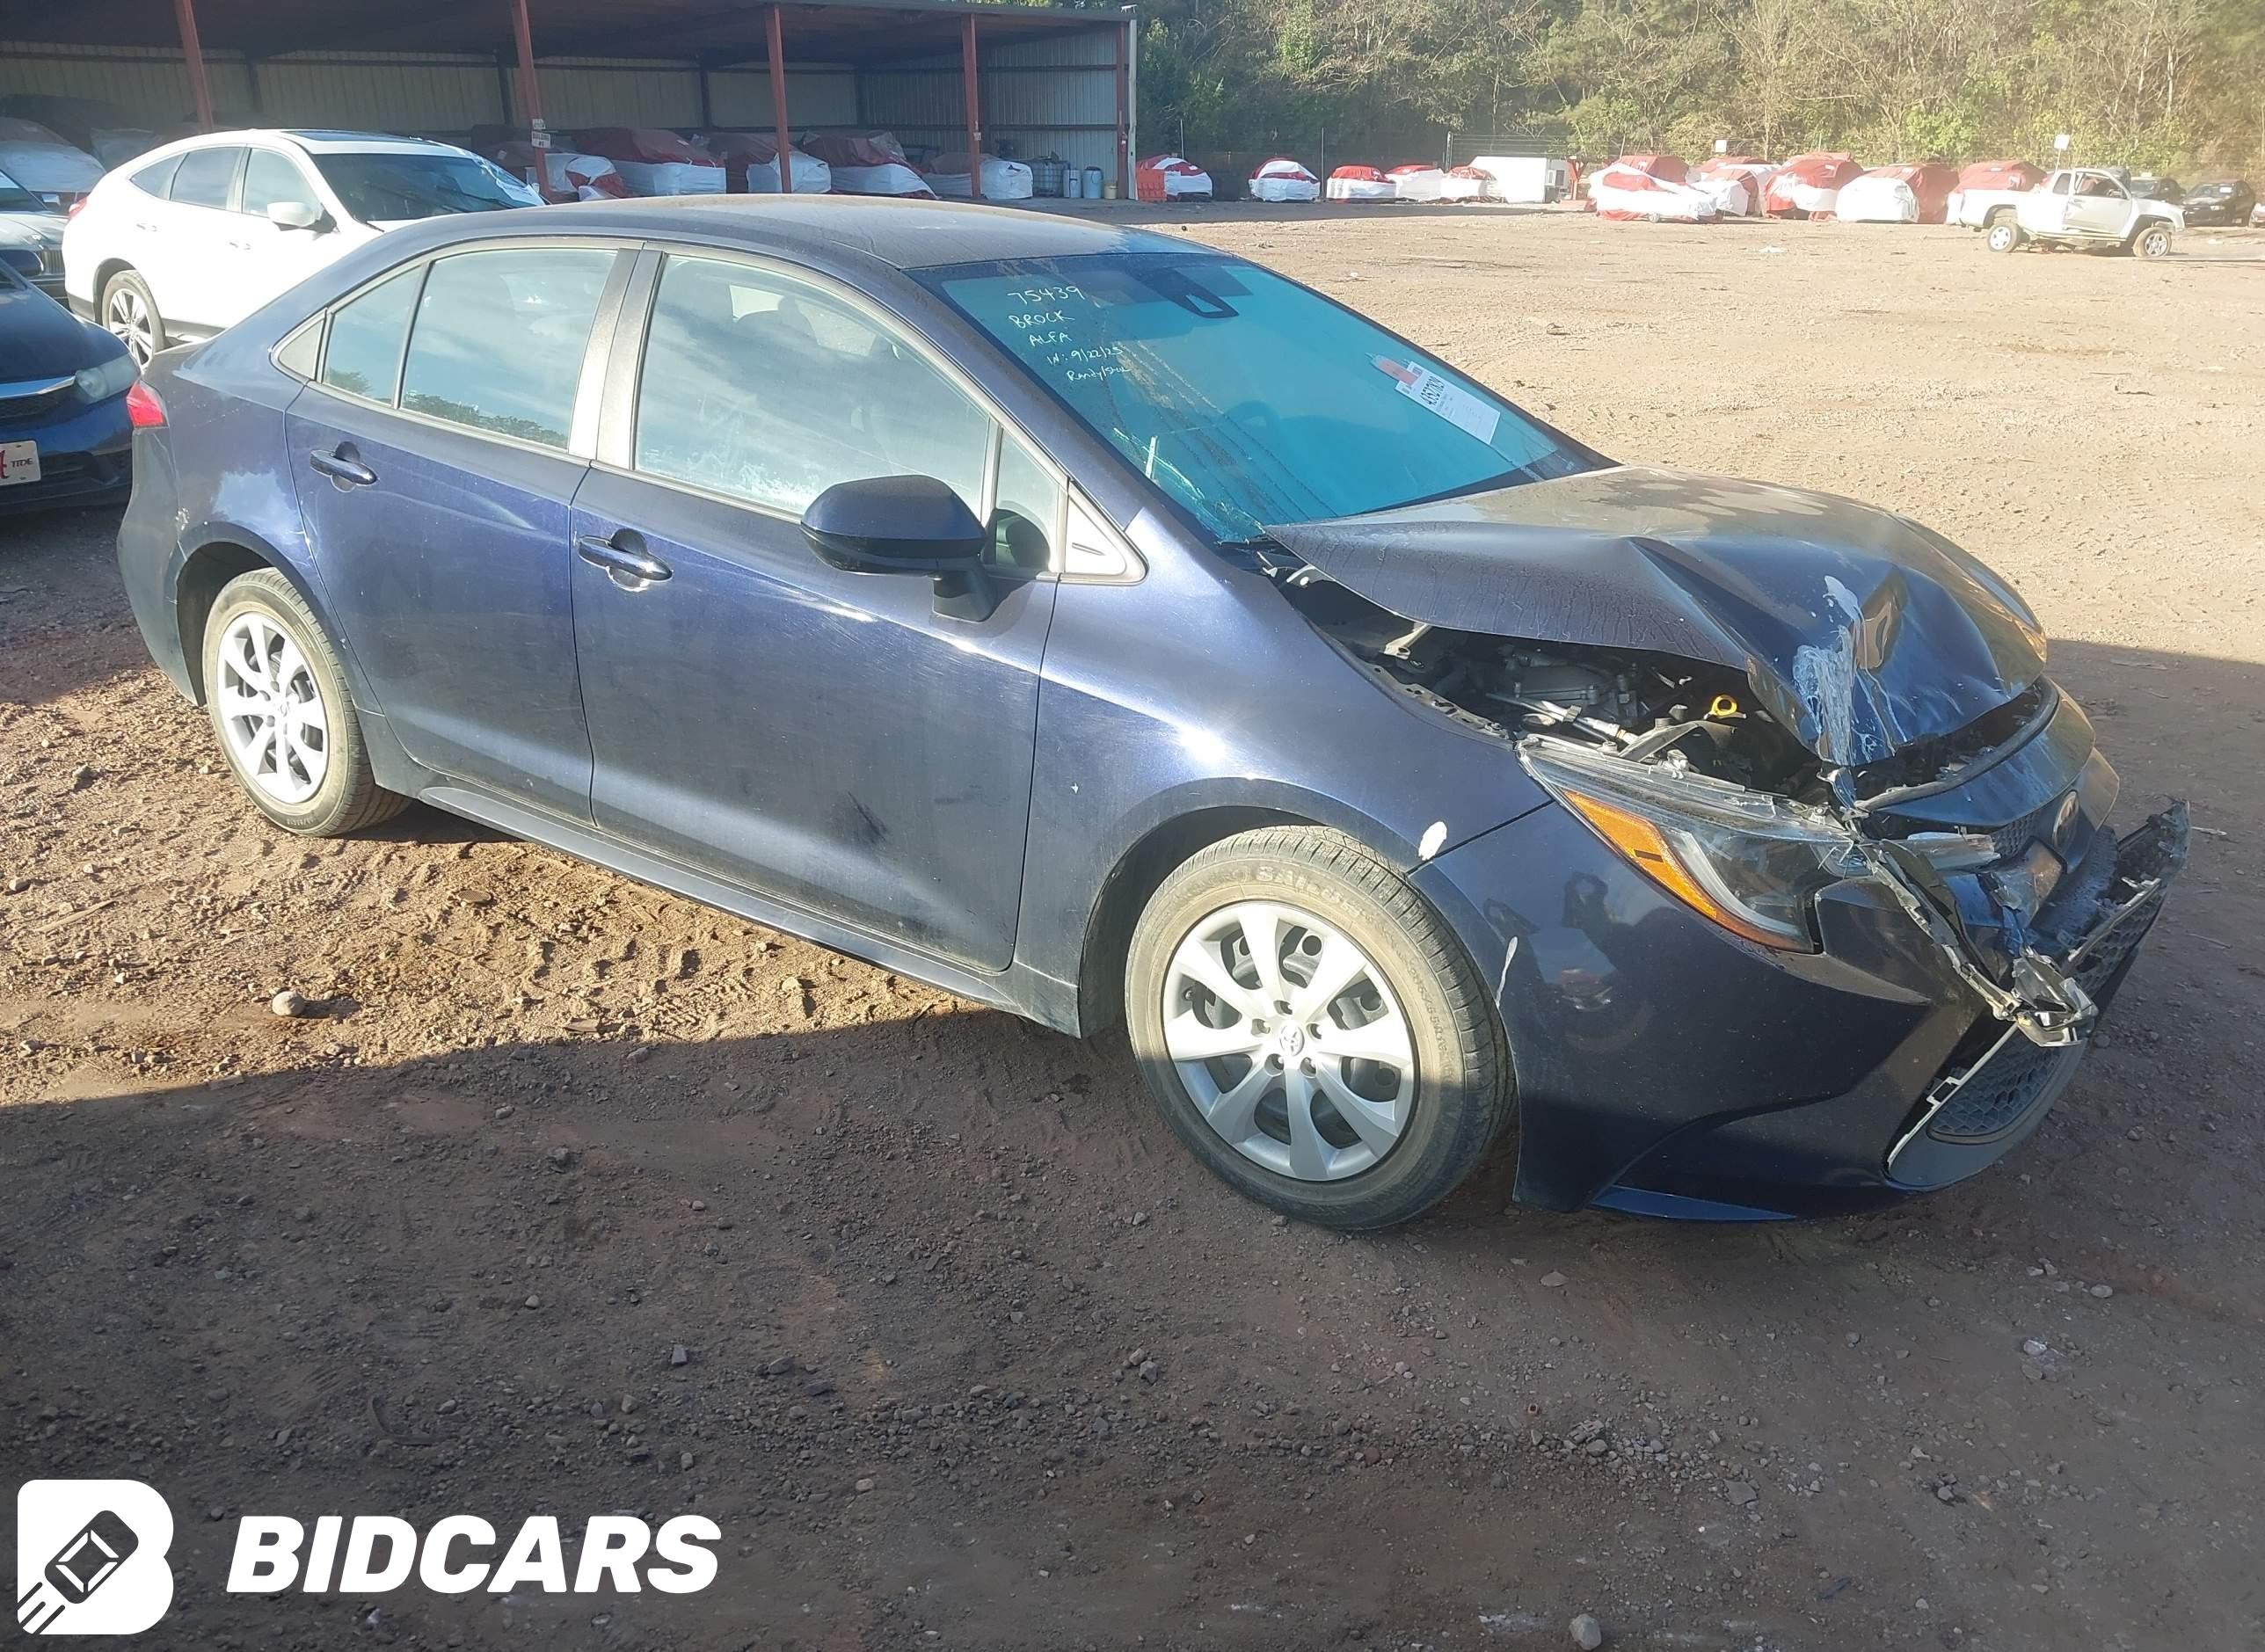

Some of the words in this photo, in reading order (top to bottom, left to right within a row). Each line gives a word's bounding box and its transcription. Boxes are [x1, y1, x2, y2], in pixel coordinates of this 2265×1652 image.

[1007, 286, 1085, 305] 75439
[1009, 309, 1075, 329] BROCK
[1028, 331, 1073, 347] ALFA
[11, 457, 33, 468] TIDE
